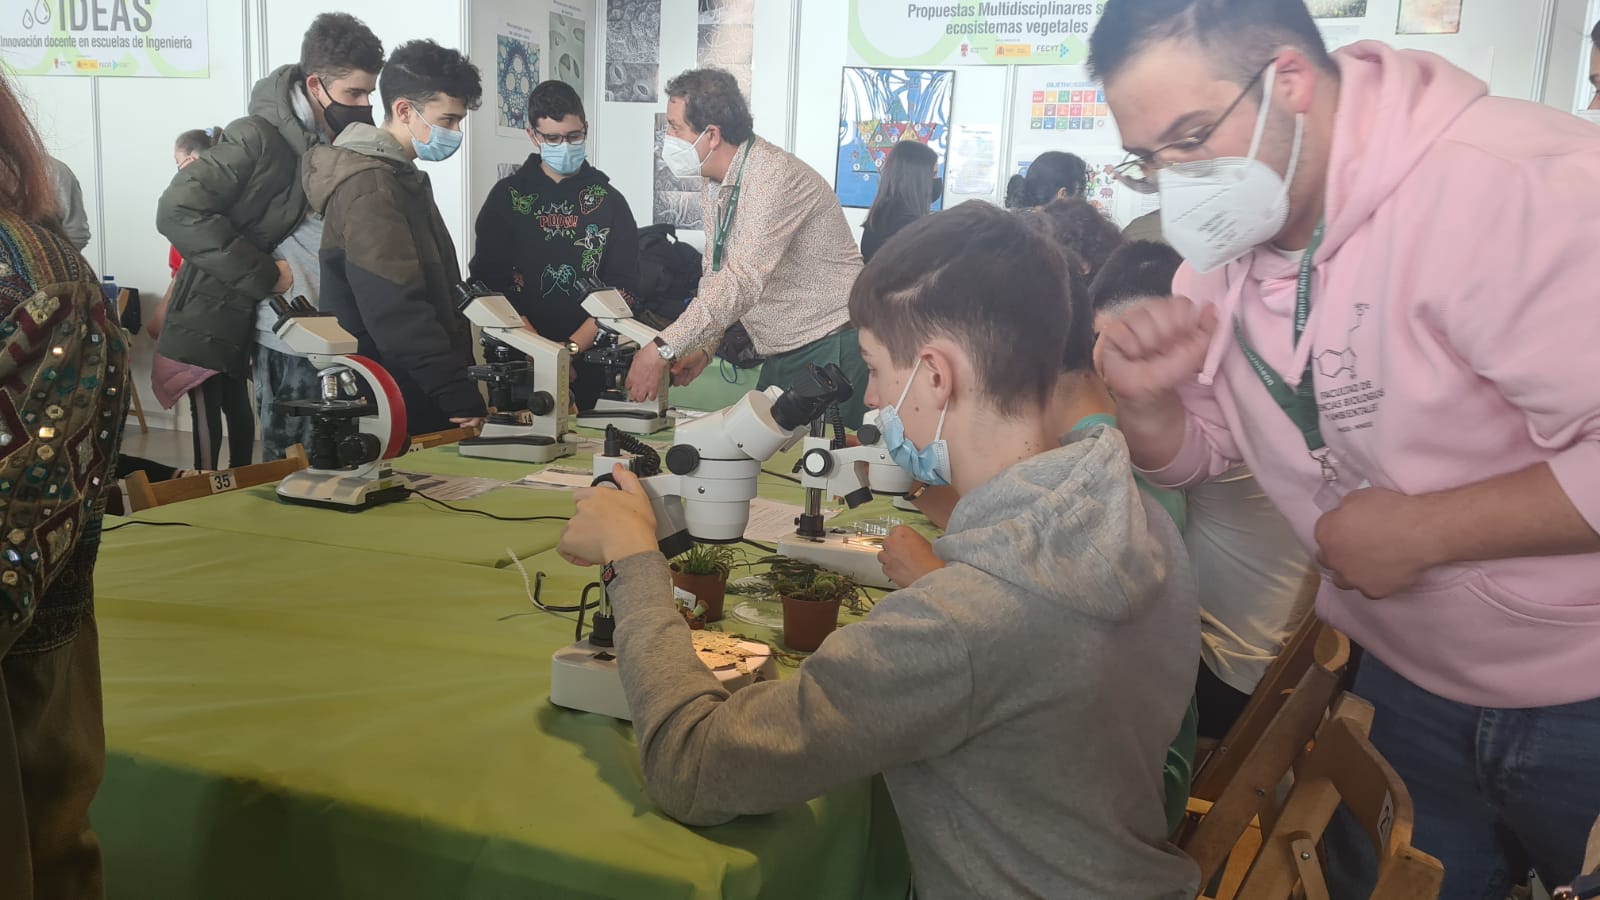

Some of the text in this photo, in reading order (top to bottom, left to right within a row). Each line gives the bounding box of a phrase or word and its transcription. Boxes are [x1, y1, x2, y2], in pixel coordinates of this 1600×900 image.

[59, 0, 152, 32] IDEAS
[908, 3, 975, 20] Propuestas
[978, 0, 1092, 18] Multidisciplinares
[945, 19, 1089, 36] ecosistemas vegetales
[0, 35, 192, 51] Innovación docente en escuelas de Ingeniería
[214, 473, 231, 490] 35
